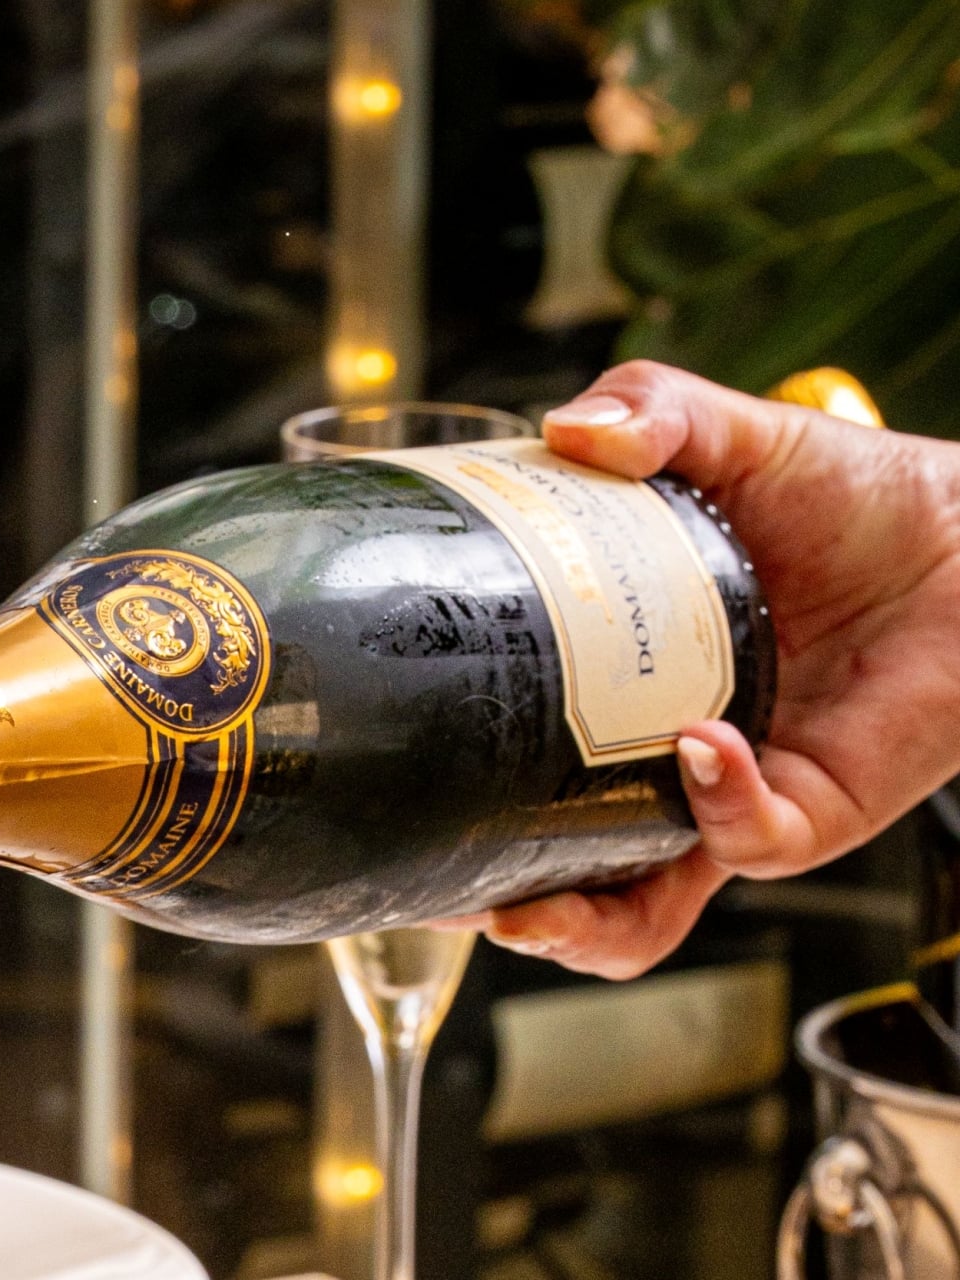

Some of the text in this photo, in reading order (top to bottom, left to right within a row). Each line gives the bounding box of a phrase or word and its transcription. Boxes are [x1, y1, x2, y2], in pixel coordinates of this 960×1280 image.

[59, 584, 193, 722] DOMAINE CARNEROS
[109, 802, 199, 886] DOMAINE
